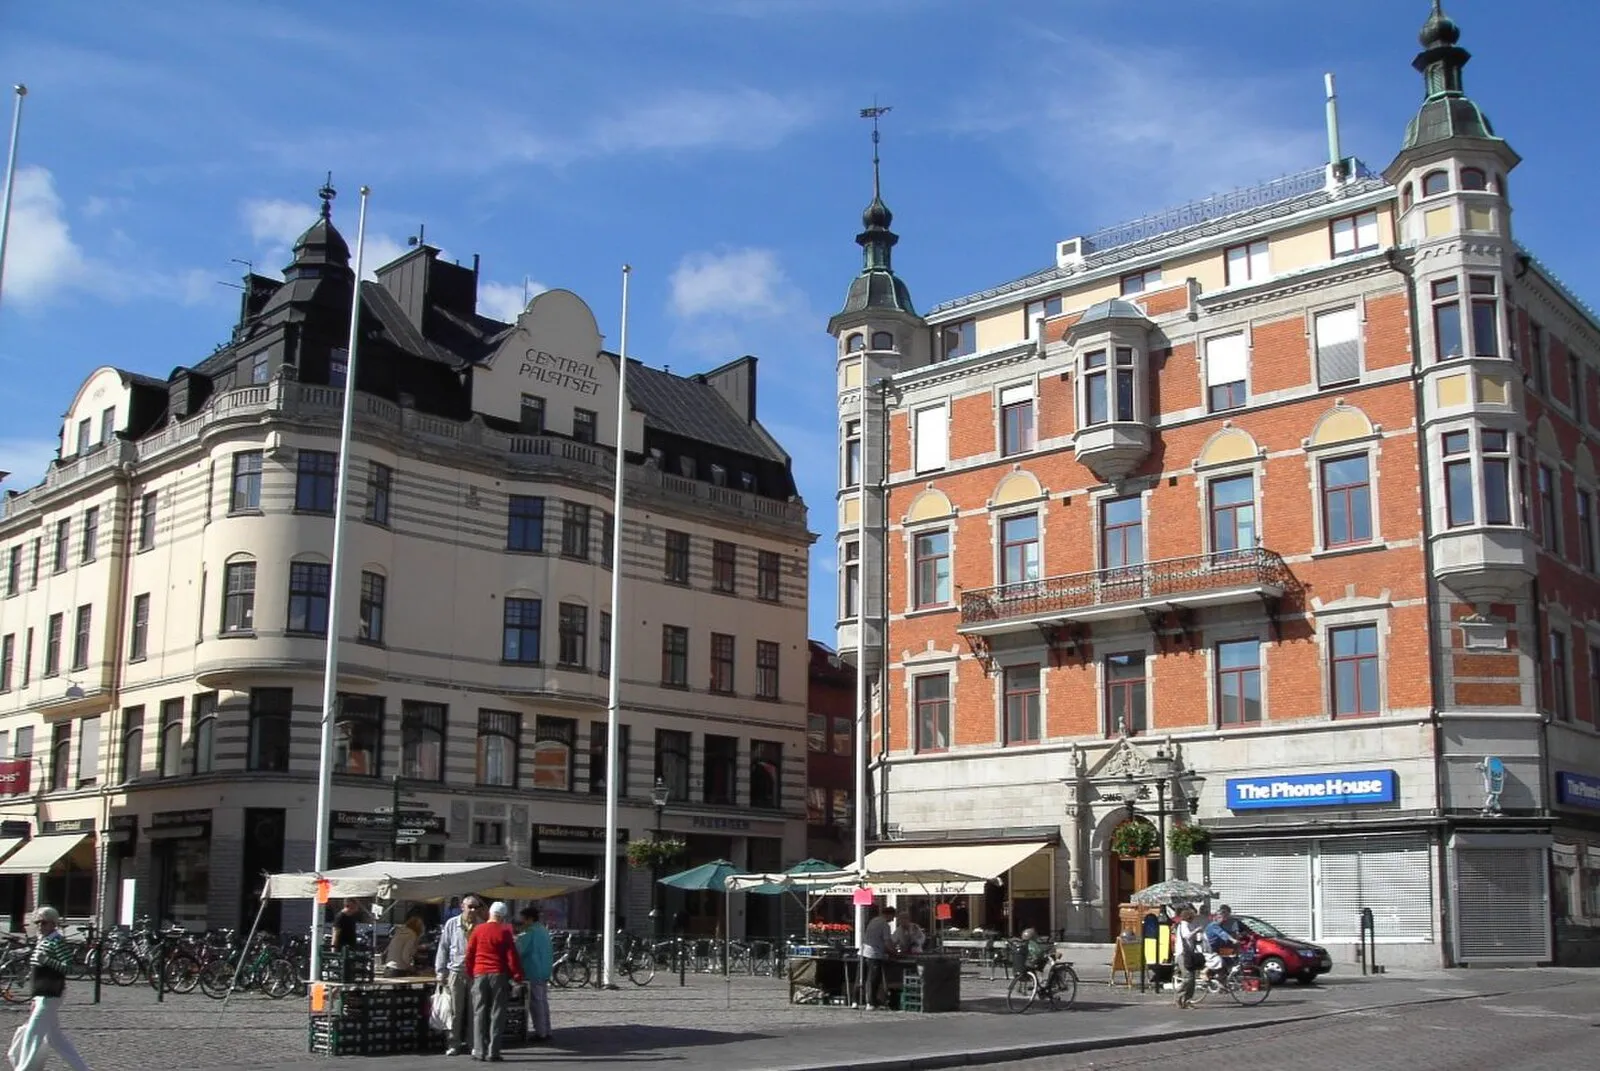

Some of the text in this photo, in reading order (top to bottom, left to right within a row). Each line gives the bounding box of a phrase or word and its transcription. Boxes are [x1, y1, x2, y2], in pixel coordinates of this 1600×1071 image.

[518, 363, 602, 395] PALATSET
[525, 348, 597, 380] CENTRAL
[1236, 779, 1382, 799] The Phone House
